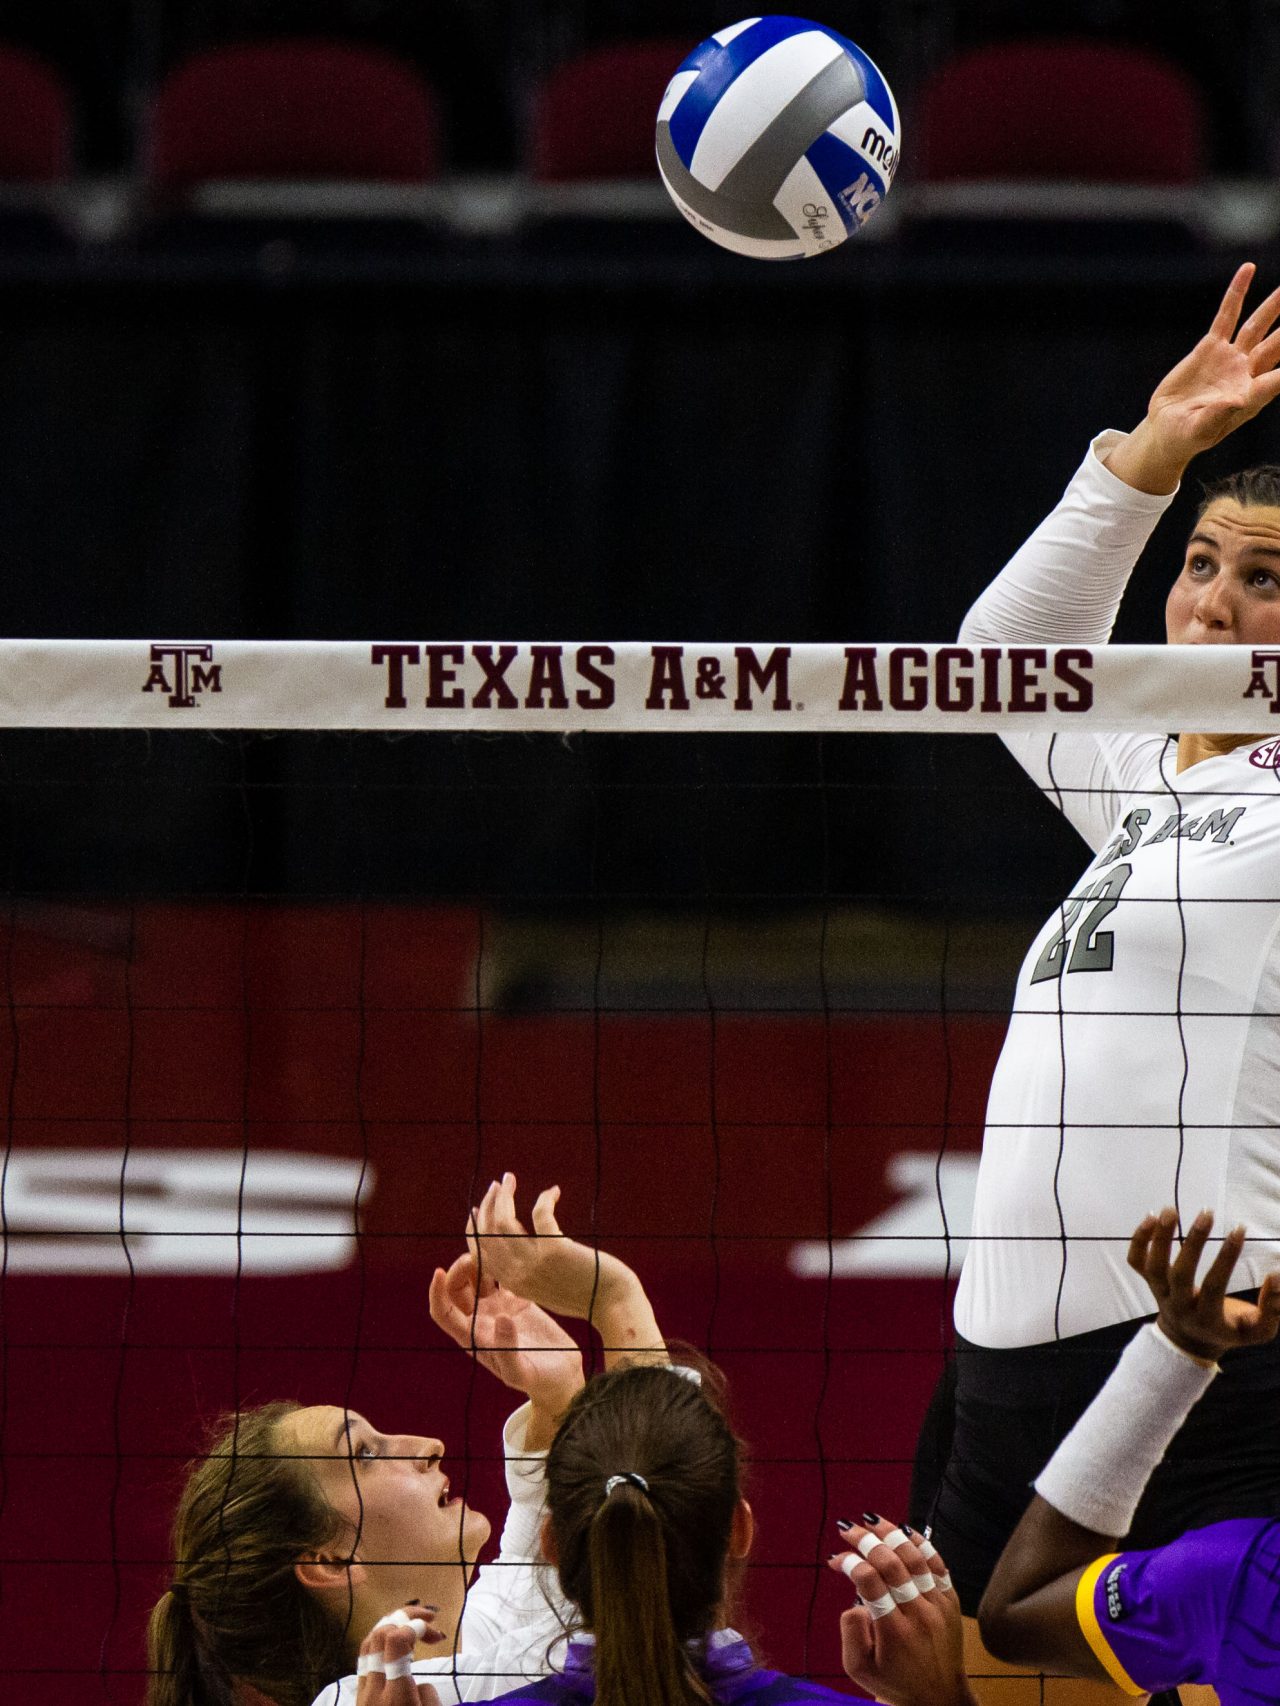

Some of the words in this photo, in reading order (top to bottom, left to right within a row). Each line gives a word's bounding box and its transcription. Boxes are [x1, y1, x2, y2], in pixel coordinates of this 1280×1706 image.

[838, 172, 881, 225] NC
[370, 645, 616, 710] TEXAS
[645, 645, 793, 711] A&M
[838, 647, 1095, 713] AGGIES
[1029, 863, 1133, 985] 22
